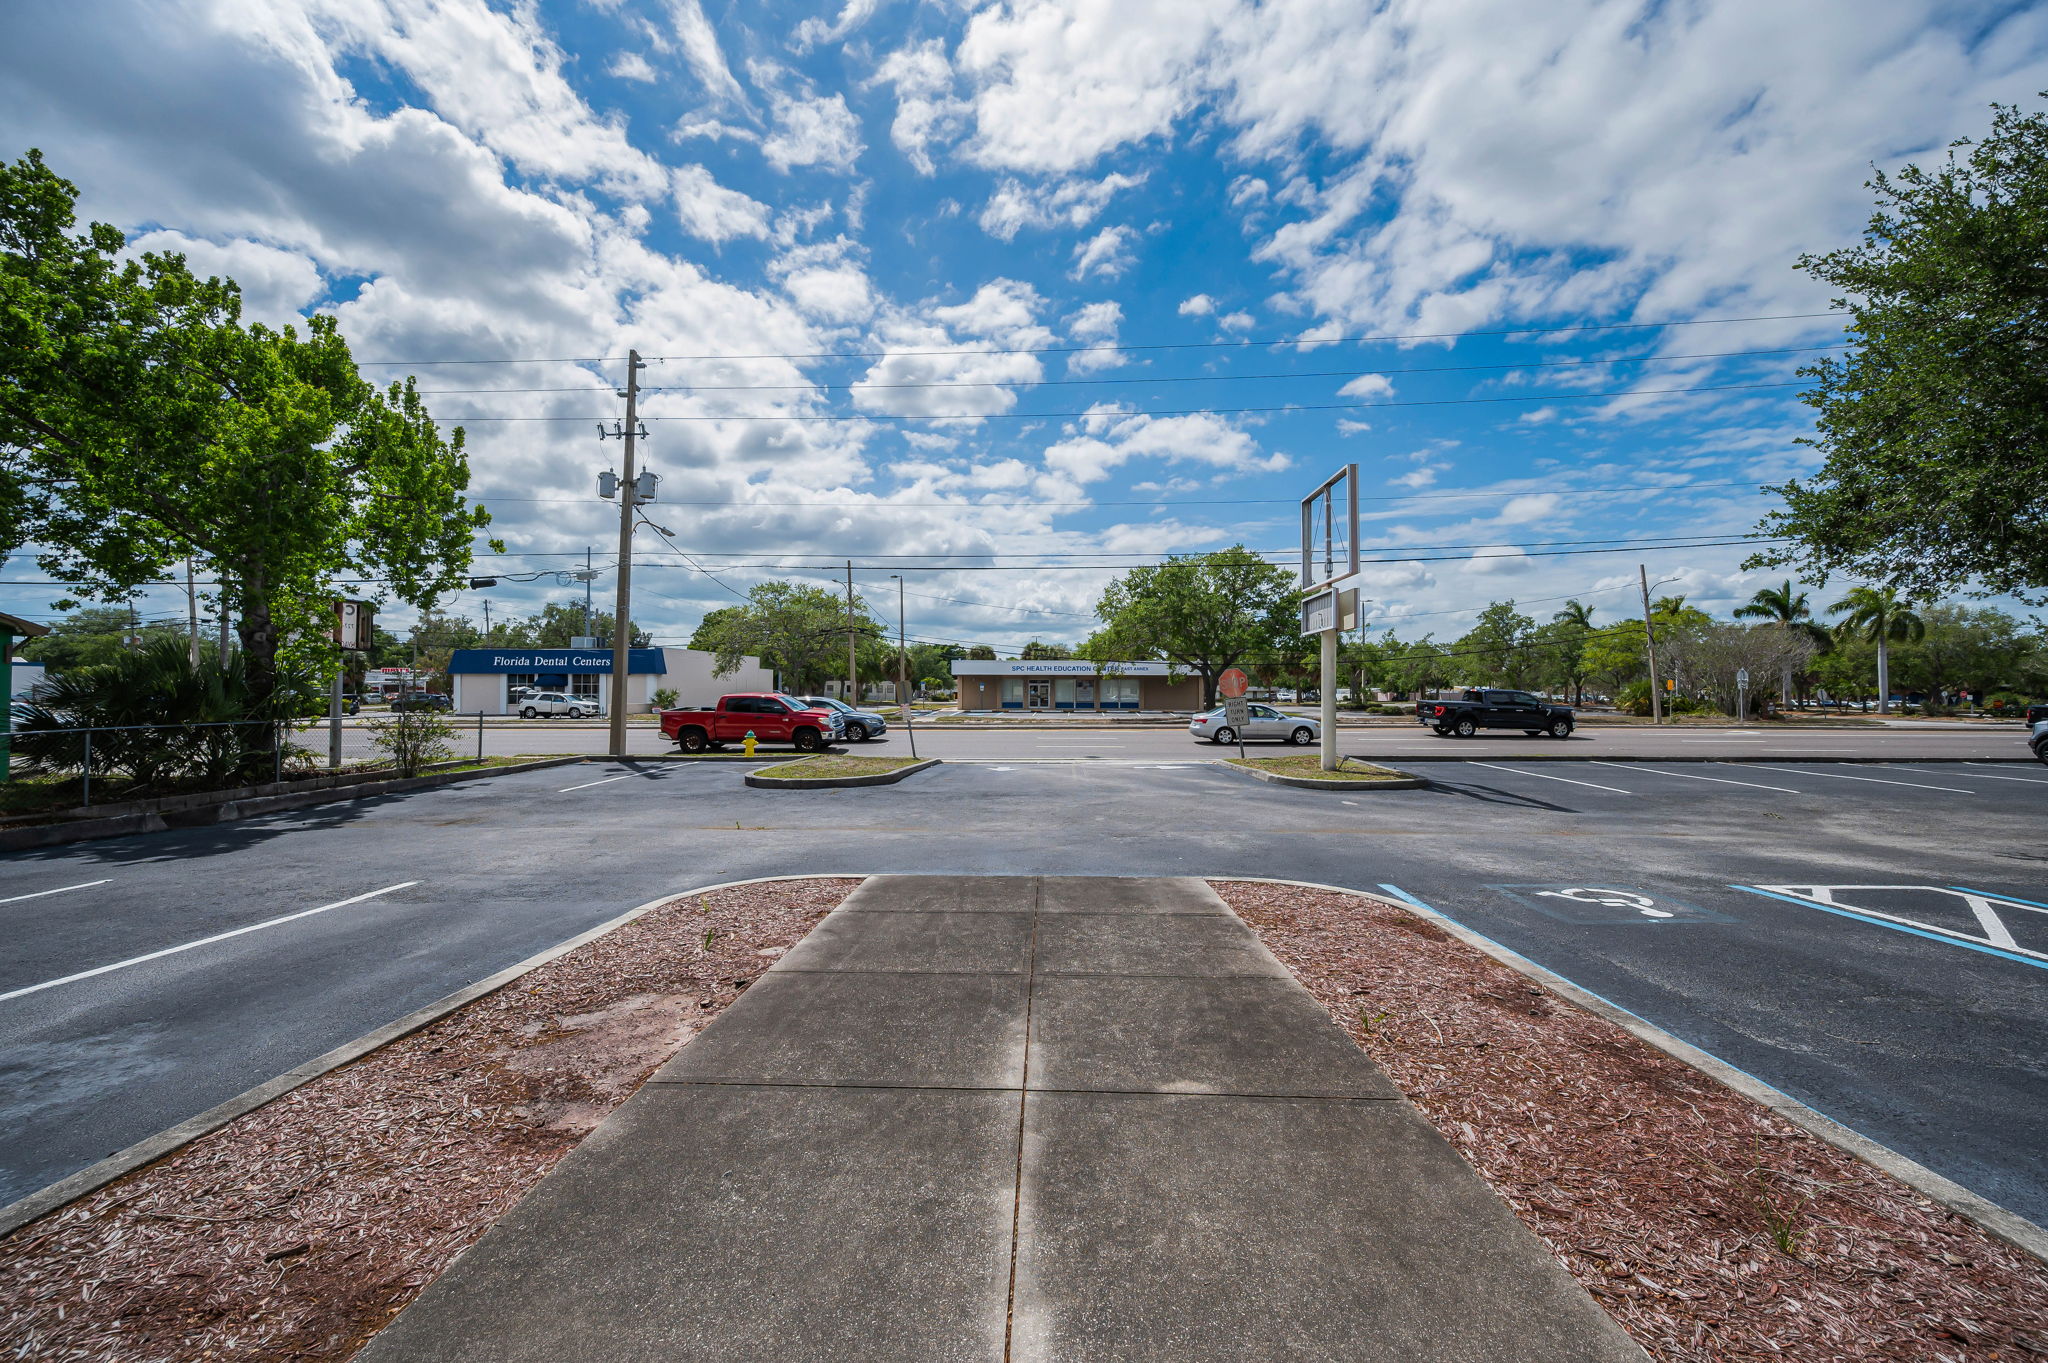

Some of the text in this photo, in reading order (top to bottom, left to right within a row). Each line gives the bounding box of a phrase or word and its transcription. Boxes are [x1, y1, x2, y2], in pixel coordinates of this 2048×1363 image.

[493, 656, 611, 667] Florida Dental Centers
[1220, 677, 1245, 688] STOP
